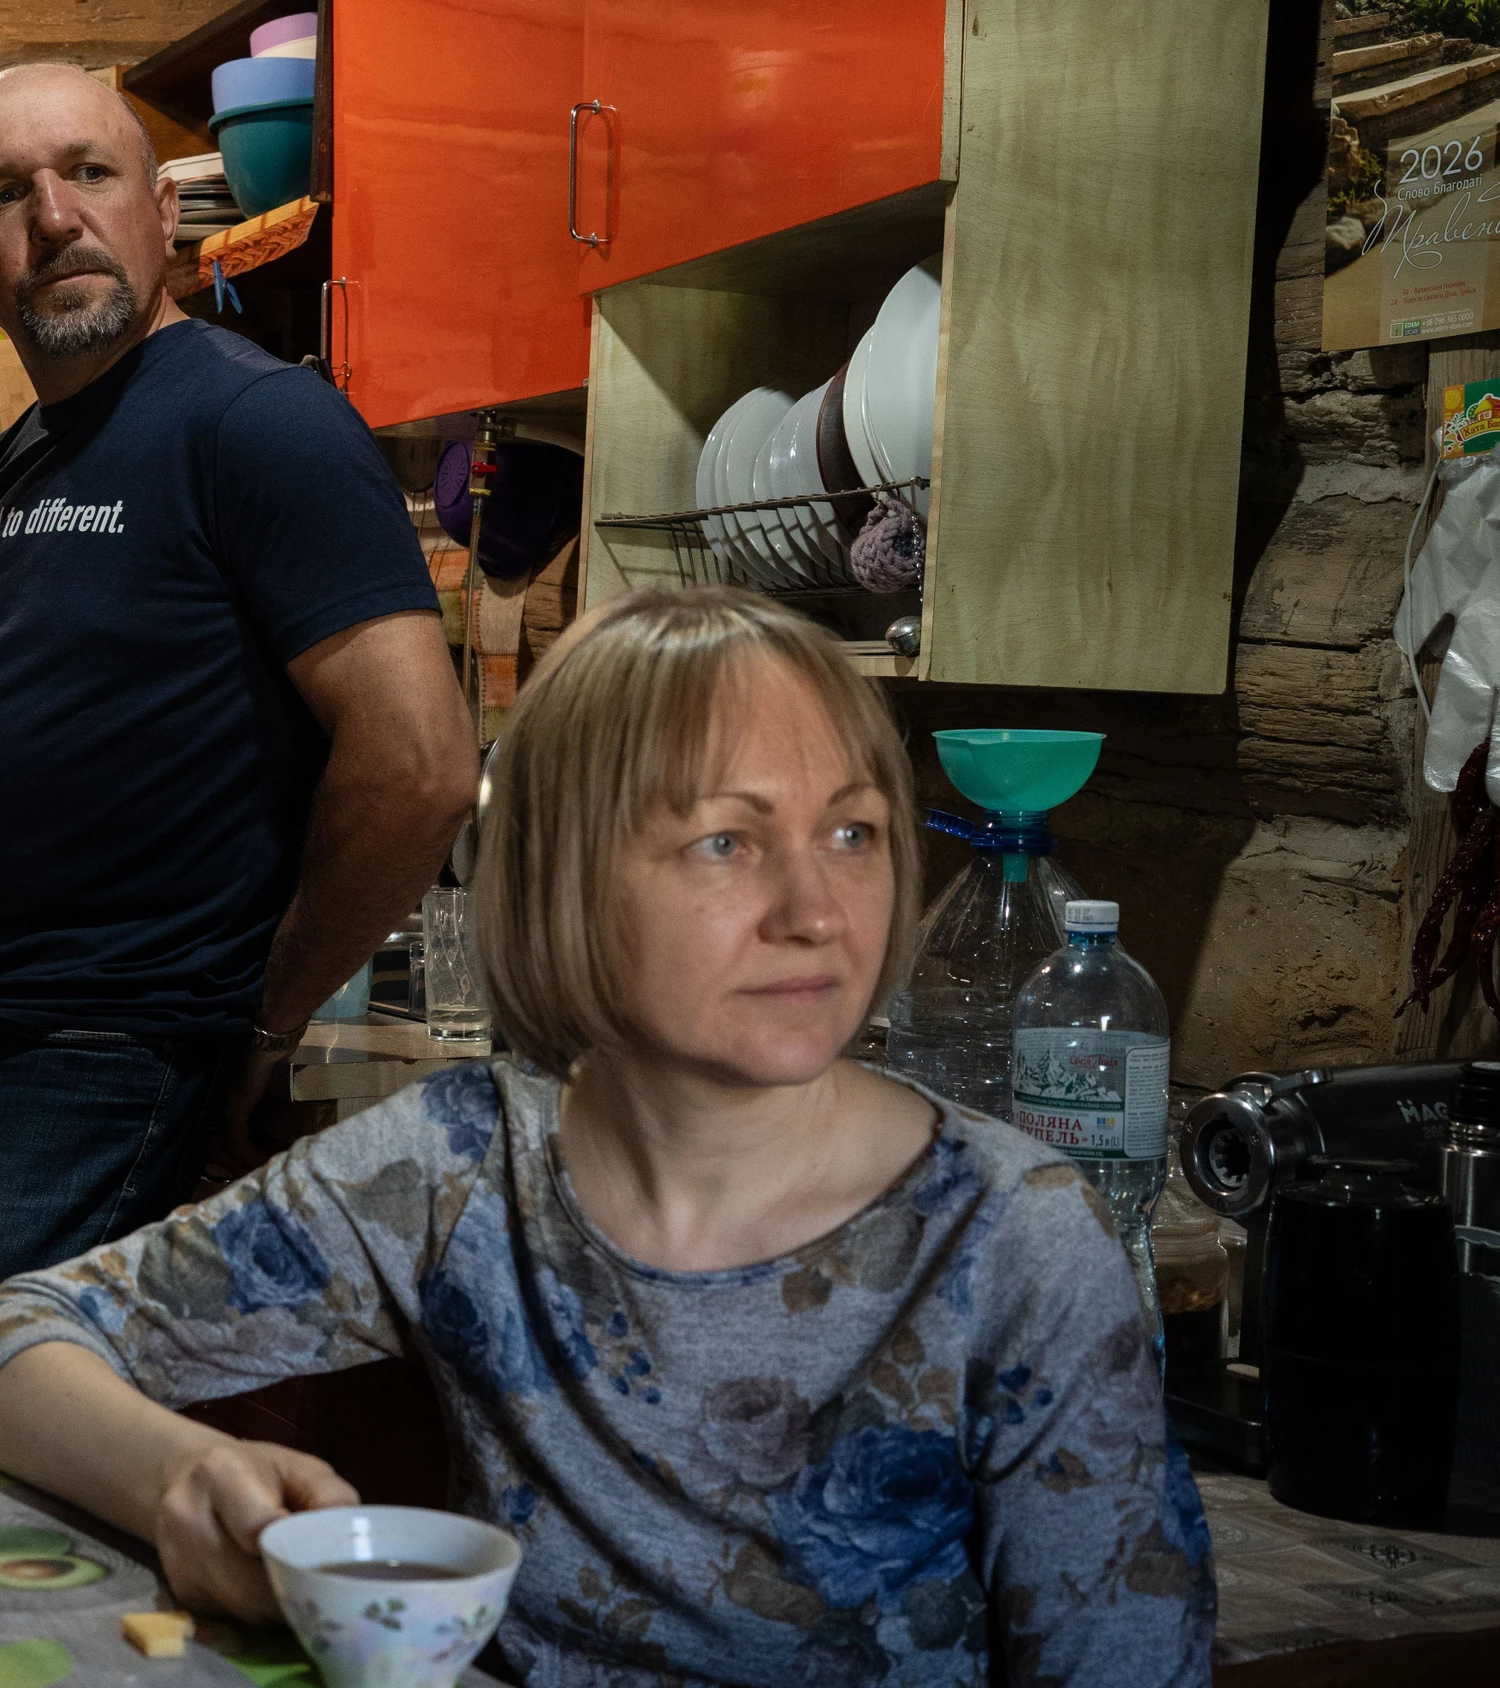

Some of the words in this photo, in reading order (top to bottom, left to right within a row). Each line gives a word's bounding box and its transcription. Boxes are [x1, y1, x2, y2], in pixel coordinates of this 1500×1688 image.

[1398, 136, 1483, 184] 2026
[1397, 186, 1430, 201] Слово
[1433, 173, 1483, 195] Благодаті
[1404, 321, 1420, 329] EDEM
[1458, 312, 1474, 321] 0000
[1421, 322, 1474, 334] www.edem-store.com
[1463, 421, 1485, 437] Хата
[2, 506, 24, 538] to
[24, 497, 125, 535] different.
[1069, 1055, 1093, 1065] Своя
[1093, 1054, 1118, 1067] Лінія
[1091, 1134, 1103, 1148] 1,5
